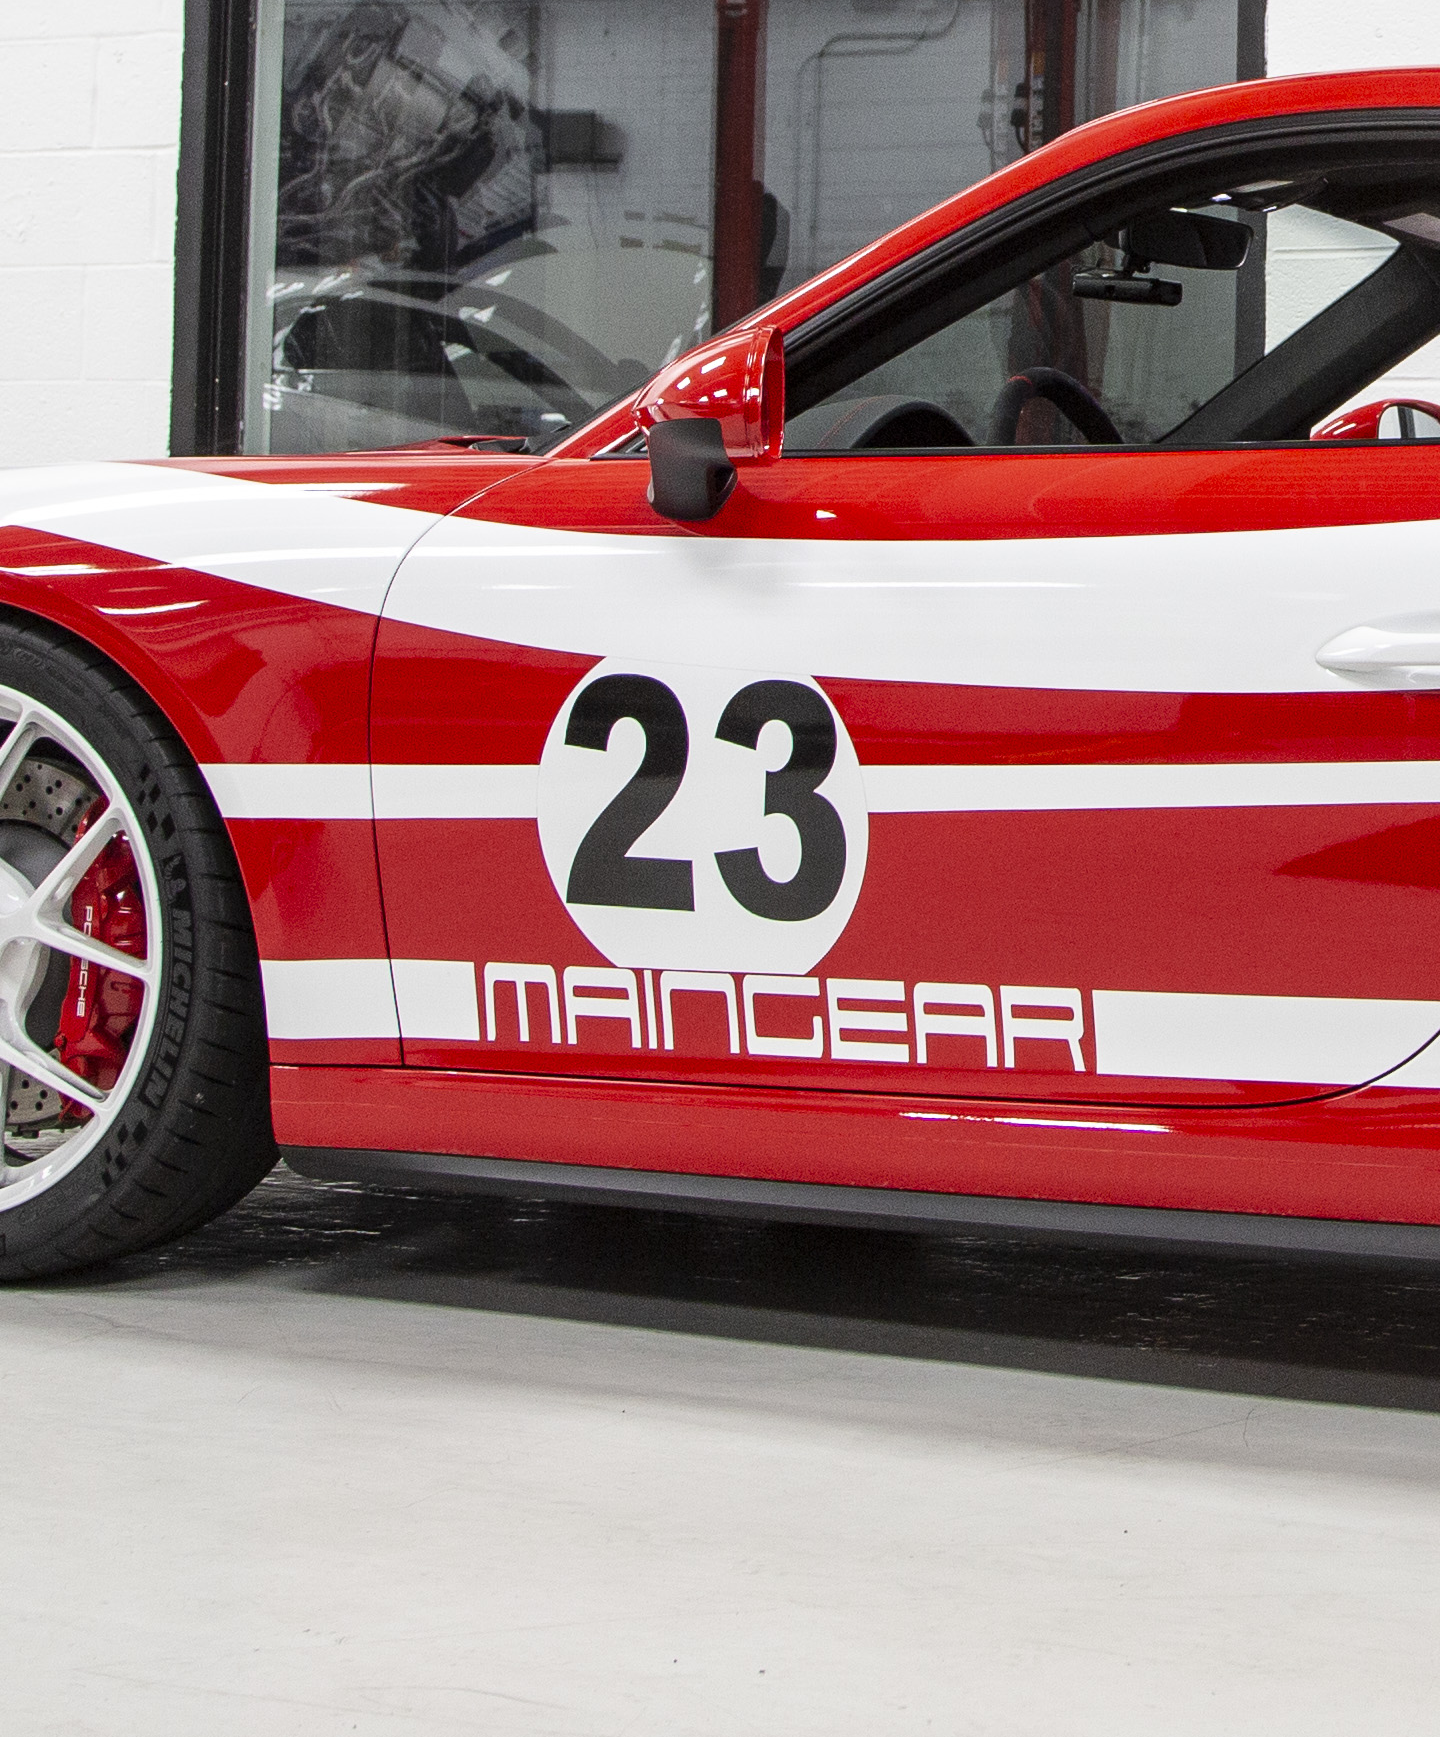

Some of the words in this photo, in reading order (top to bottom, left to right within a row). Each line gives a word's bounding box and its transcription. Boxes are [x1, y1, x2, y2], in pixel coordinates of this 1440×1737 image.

[563, 672, 848, 923] 23
[75, 905, 93, 1018] POSCHE
[143, 908, 193, 1108] MICHELIN
[483, 961, 1088, 1073] MAINGEAR
